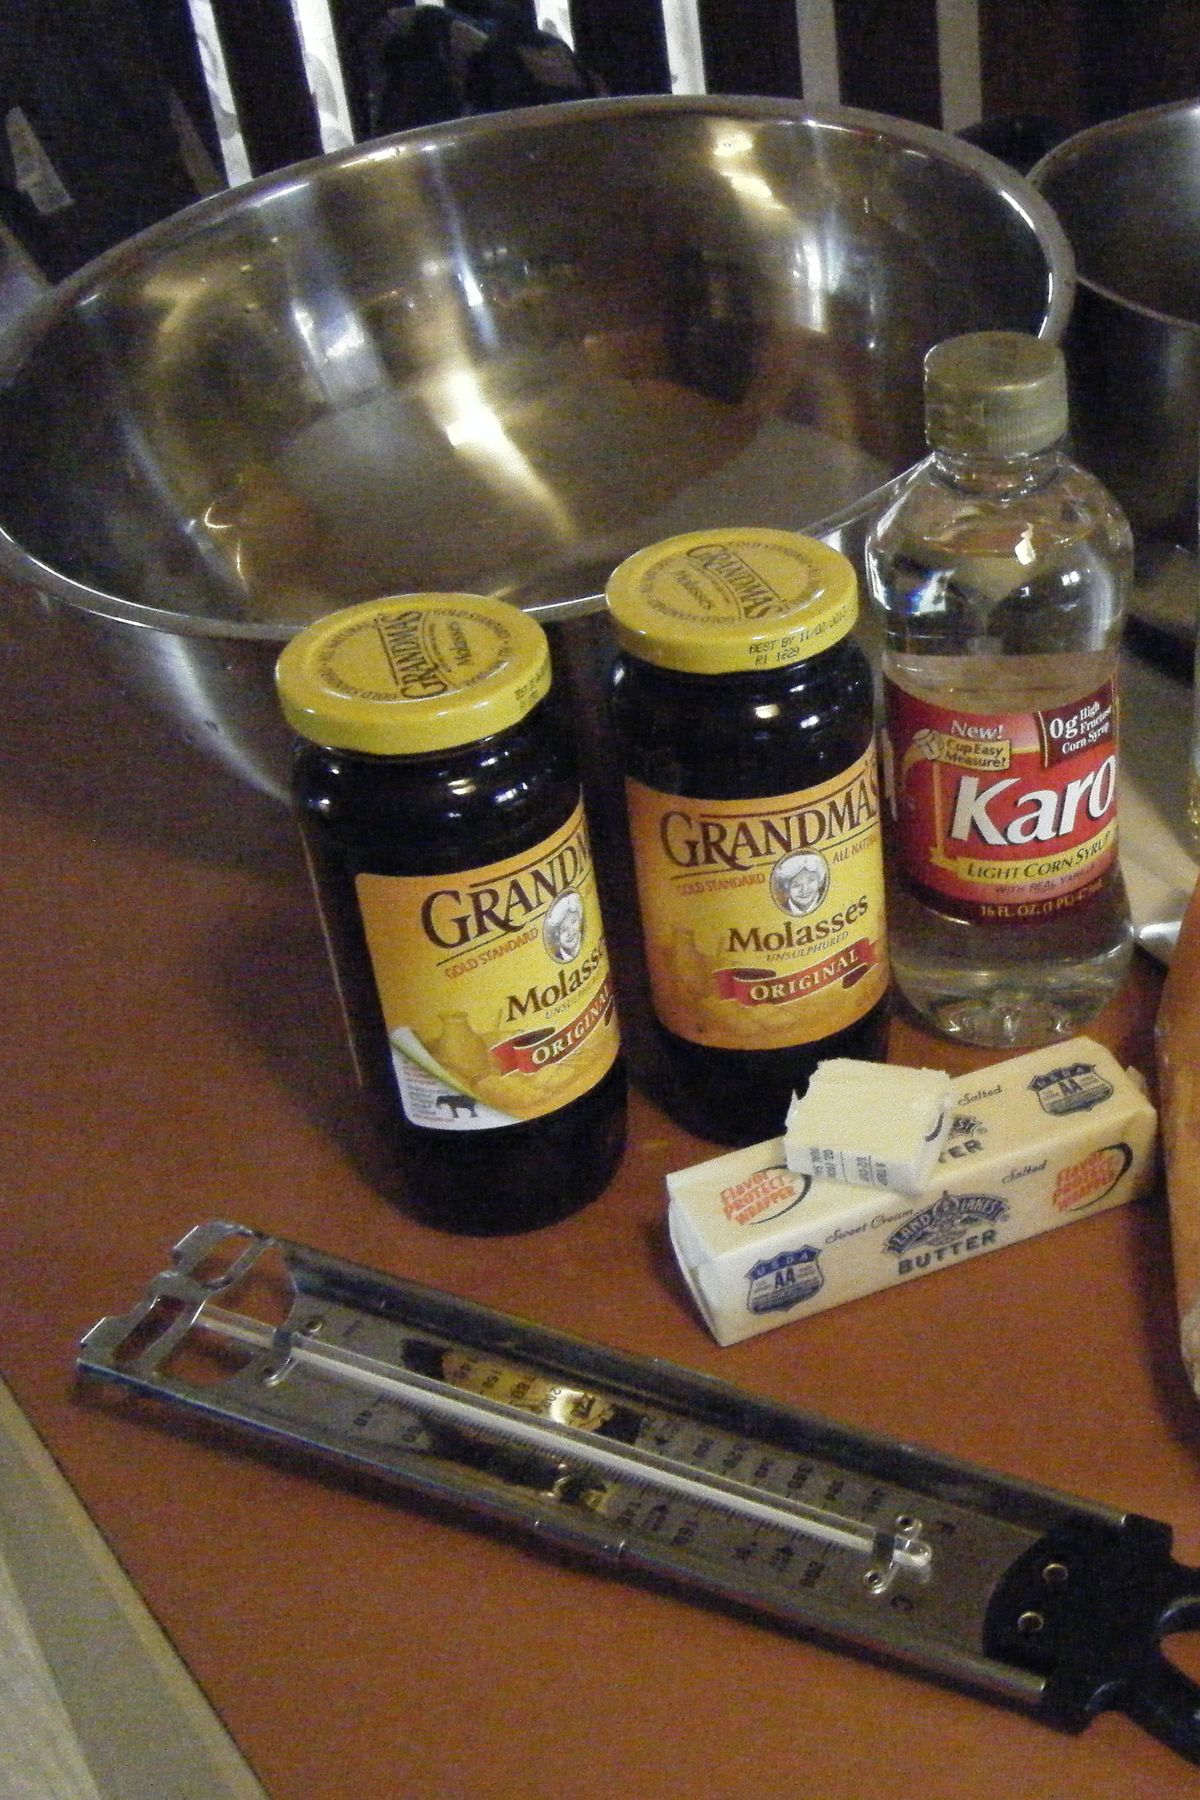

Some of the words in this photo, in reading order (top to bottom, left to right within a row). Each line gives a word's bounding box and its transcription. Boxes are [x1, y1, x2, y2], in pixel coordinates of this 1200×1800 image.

[749, 640, 776, 655] BEST
[781, 635, 796, 649] BY
[1080, 701, 1100, 720] High
[951, 720, 1004, 740] New!
[1049, 715, 1078, 739] 0g
[973, 743, 1003, 757] Easy
[1062, 738, 1087, 754] Corn
[951, 755, 1116, 845] Karo
[967, 860, 1020, 880] LIGHT
[1023, 856, 1075, 877] CORN
[728, 895, 868, 952] Molasses
[751, 949, 858, 1001] ORIGINAL
[958, 1084, 1003, 1106] Salted
[939, 1138, 984, 1164] TER
[1001, 1160, 1047, 1184] Salted
[825, 1223, 867, 1244] Sweet
[894, 1212, 932, 1246] LAND
[898, 1228, 998, 1276] BUTTER
[774, 1267, 797, 1290] AA
